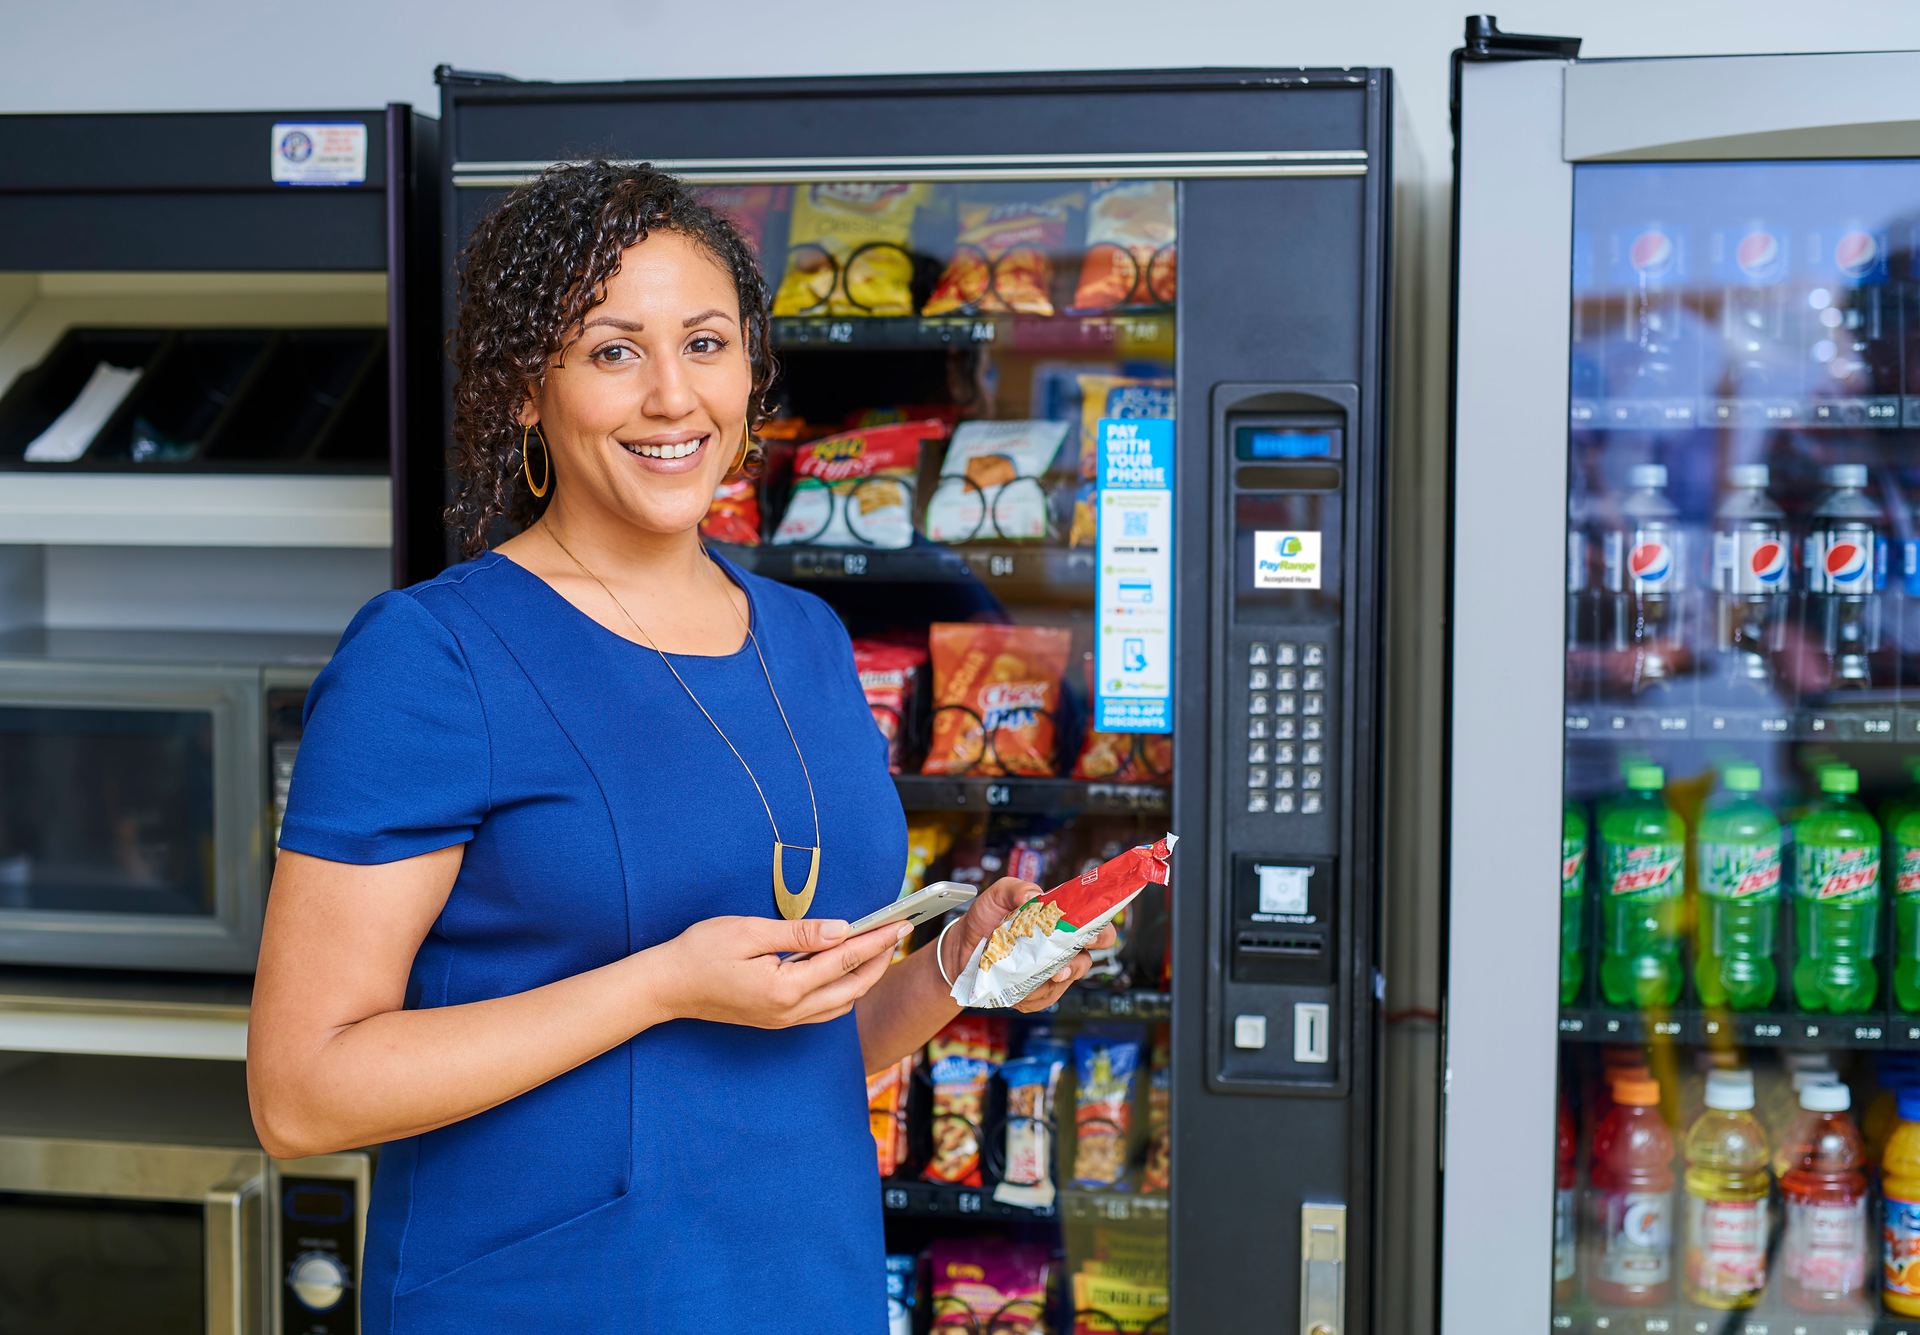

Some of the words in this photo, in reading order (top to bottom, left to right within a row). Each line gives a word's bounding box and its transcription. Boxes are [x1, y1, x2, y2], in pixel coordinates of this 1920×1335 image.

[1106, 424, 1138, 439] PAY
[1106, 439, 1151, 454] WITH
[1106, 453, 1153, 468] YOUR
[1106, 467, 1165, 482] PHONE
[844, 554, 867, 575] B2
[1259, 560, 1316, 572] PayRange
[1263, 575, 1294, 584] Accepted
[1255, 647, 1267, 665] A
[1282, 647, 1294, 665] B
[1309, 647, 1321, 665] C
[1254, 672, 1267, 689] D
[1282, 672, 1293, 690] E
[1309, 672, 1320, 690] F
[1104, 706, 1126, 716] AND
[1254, 696, 1267, 714] G
[1282, 696, 1294, 714] H
[1309, 697, 1319, 715] J
[1103, 716, 1165, 727] DISCOUNTS
[1256, 721, 1265, 738] 1
[1282, 721, 1293, 739] 2
[1309, 721, 1320, 739] 3
[1254, 745, 1265, 763] 4
[1281, 745, 1293, 763] 5
[1308, 746, 1320, 763] 6
[1256, 770, 1267, 787] 7
[1282, 770, 1294, 788] 8
[1308, 771, 1321, 788] 9
[986, 784, 1010, 805] C4
[1281, 795, 1293, 812] 0
[885, 1189, 908, 1210] E3
